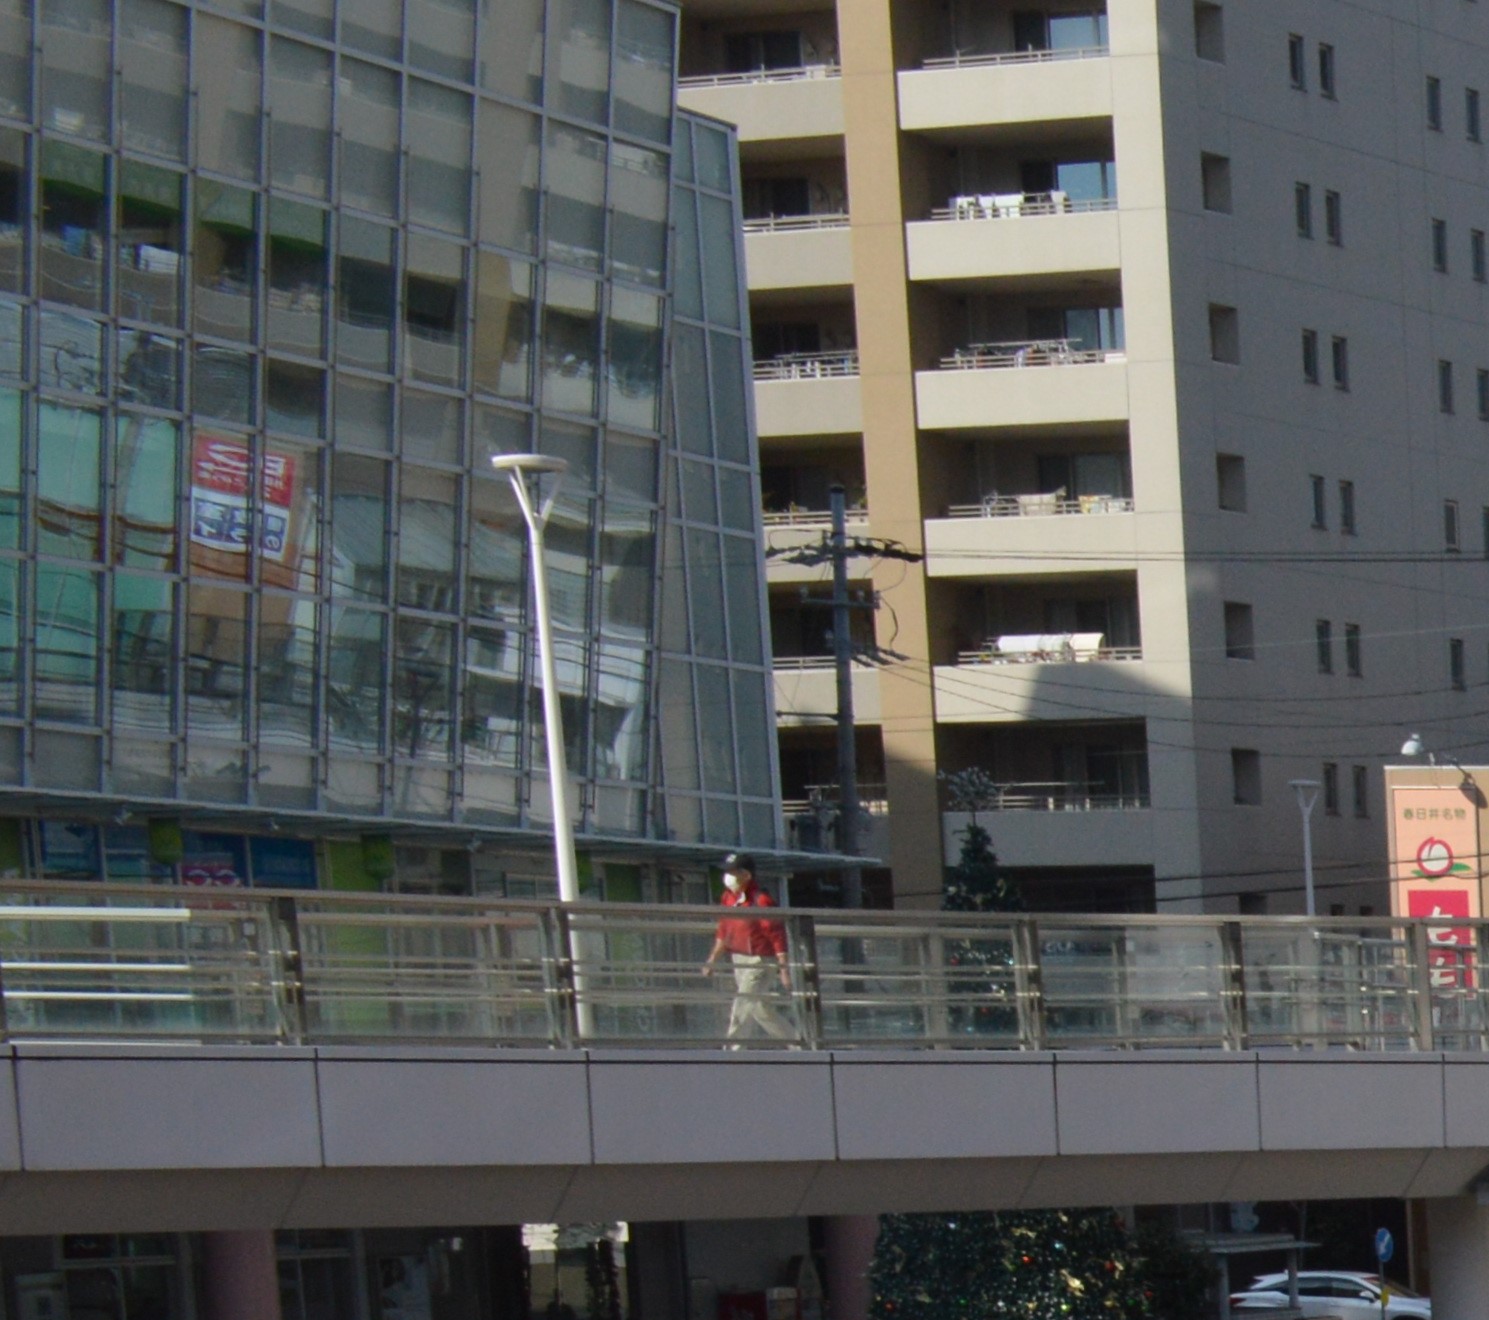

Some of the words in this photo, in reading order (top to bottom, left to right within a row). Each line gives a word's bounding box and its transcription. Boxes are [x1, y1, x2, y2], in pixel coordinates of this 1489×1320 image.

[1403, 808, 1467, 820] 春日井名物
